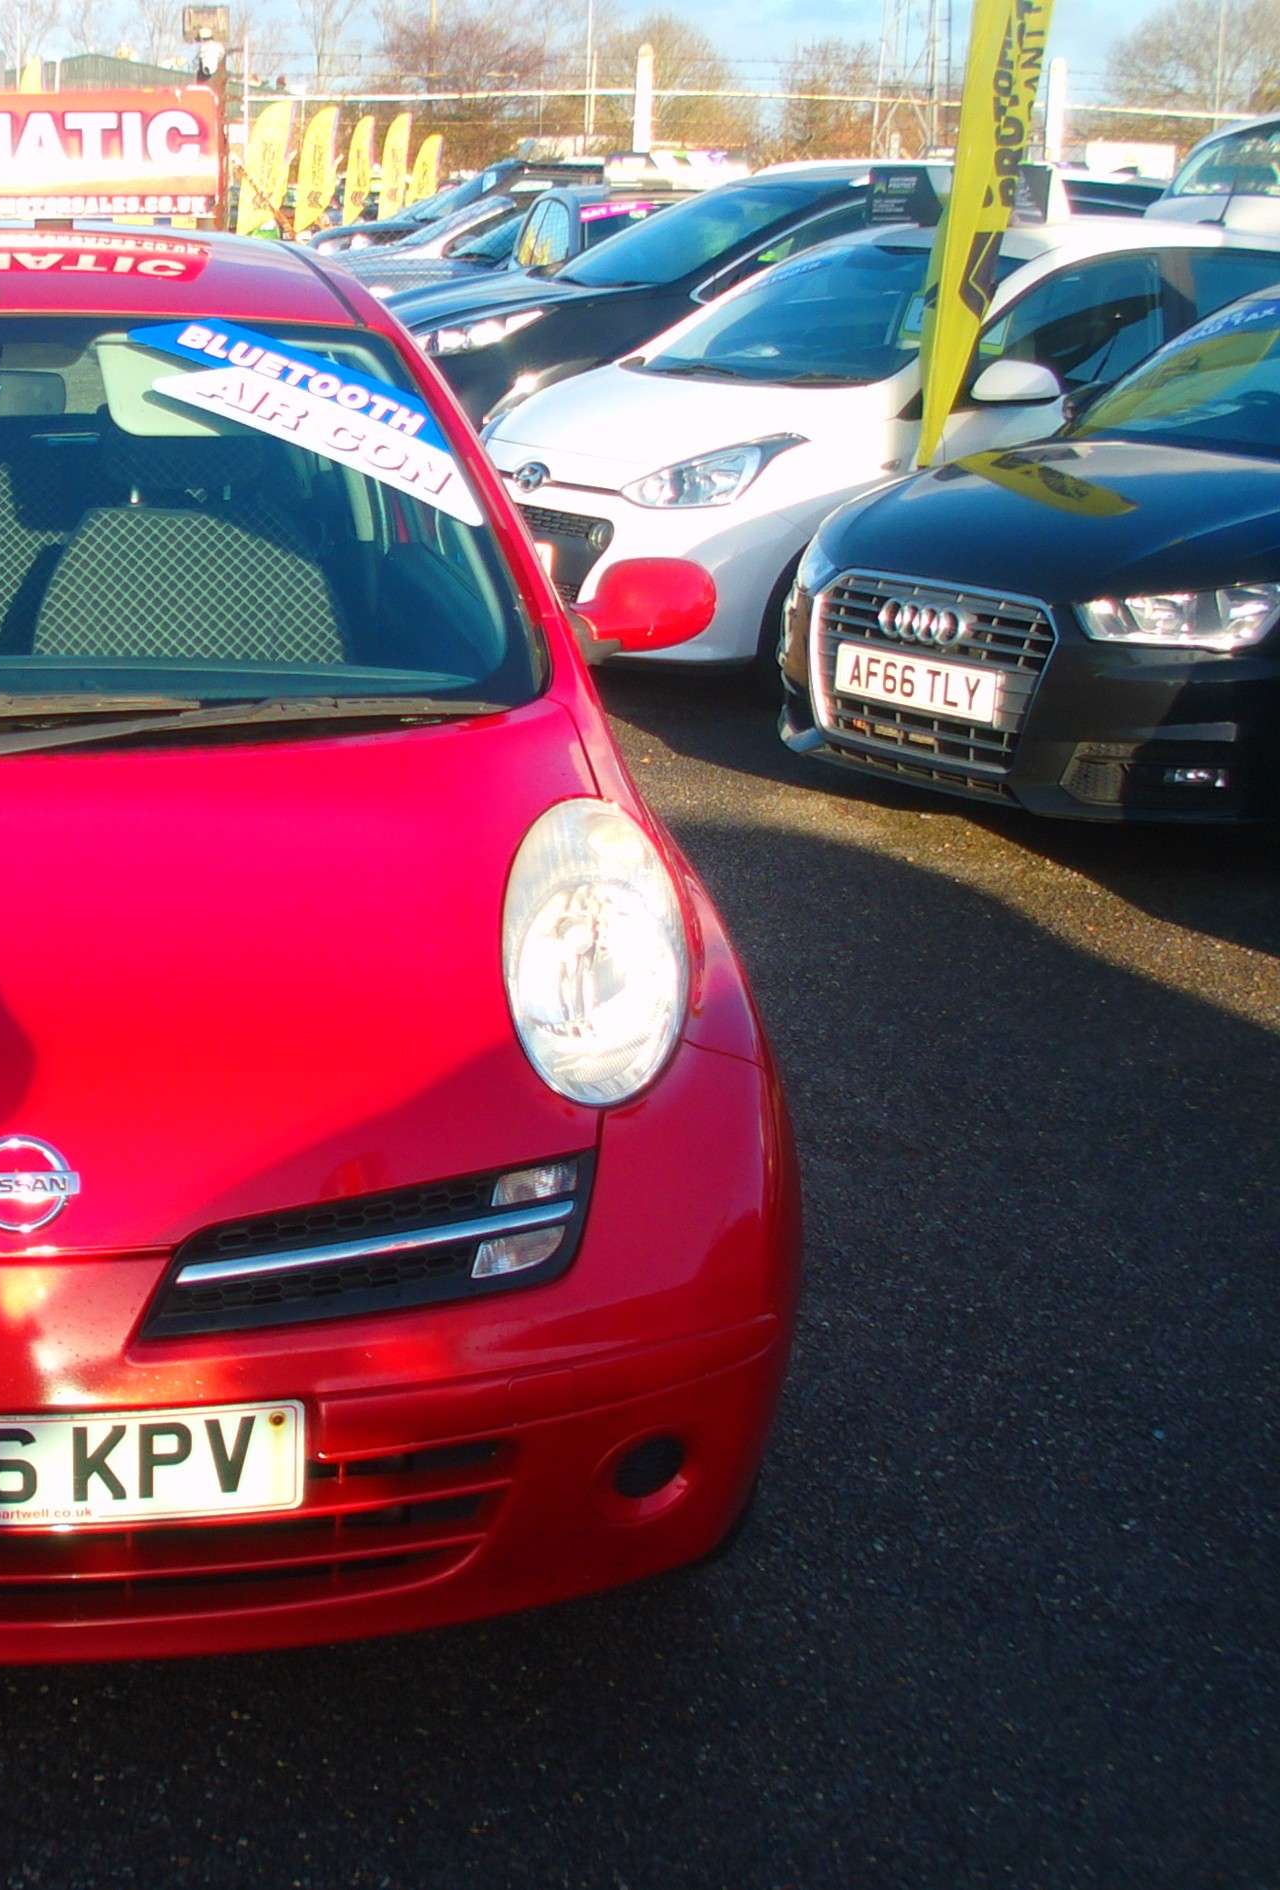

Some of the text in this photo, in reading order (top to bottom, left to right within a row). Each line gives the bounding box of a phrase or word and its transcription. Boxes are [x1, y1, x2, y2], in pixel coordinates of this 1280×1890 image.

[176, 324, 426, 436] BLUETOOTH
[195, 380, 453, 496] AIR CON
[849, 654, 981, 711] AF66 TLY
[72, 1415, 257, 1502] KPV
